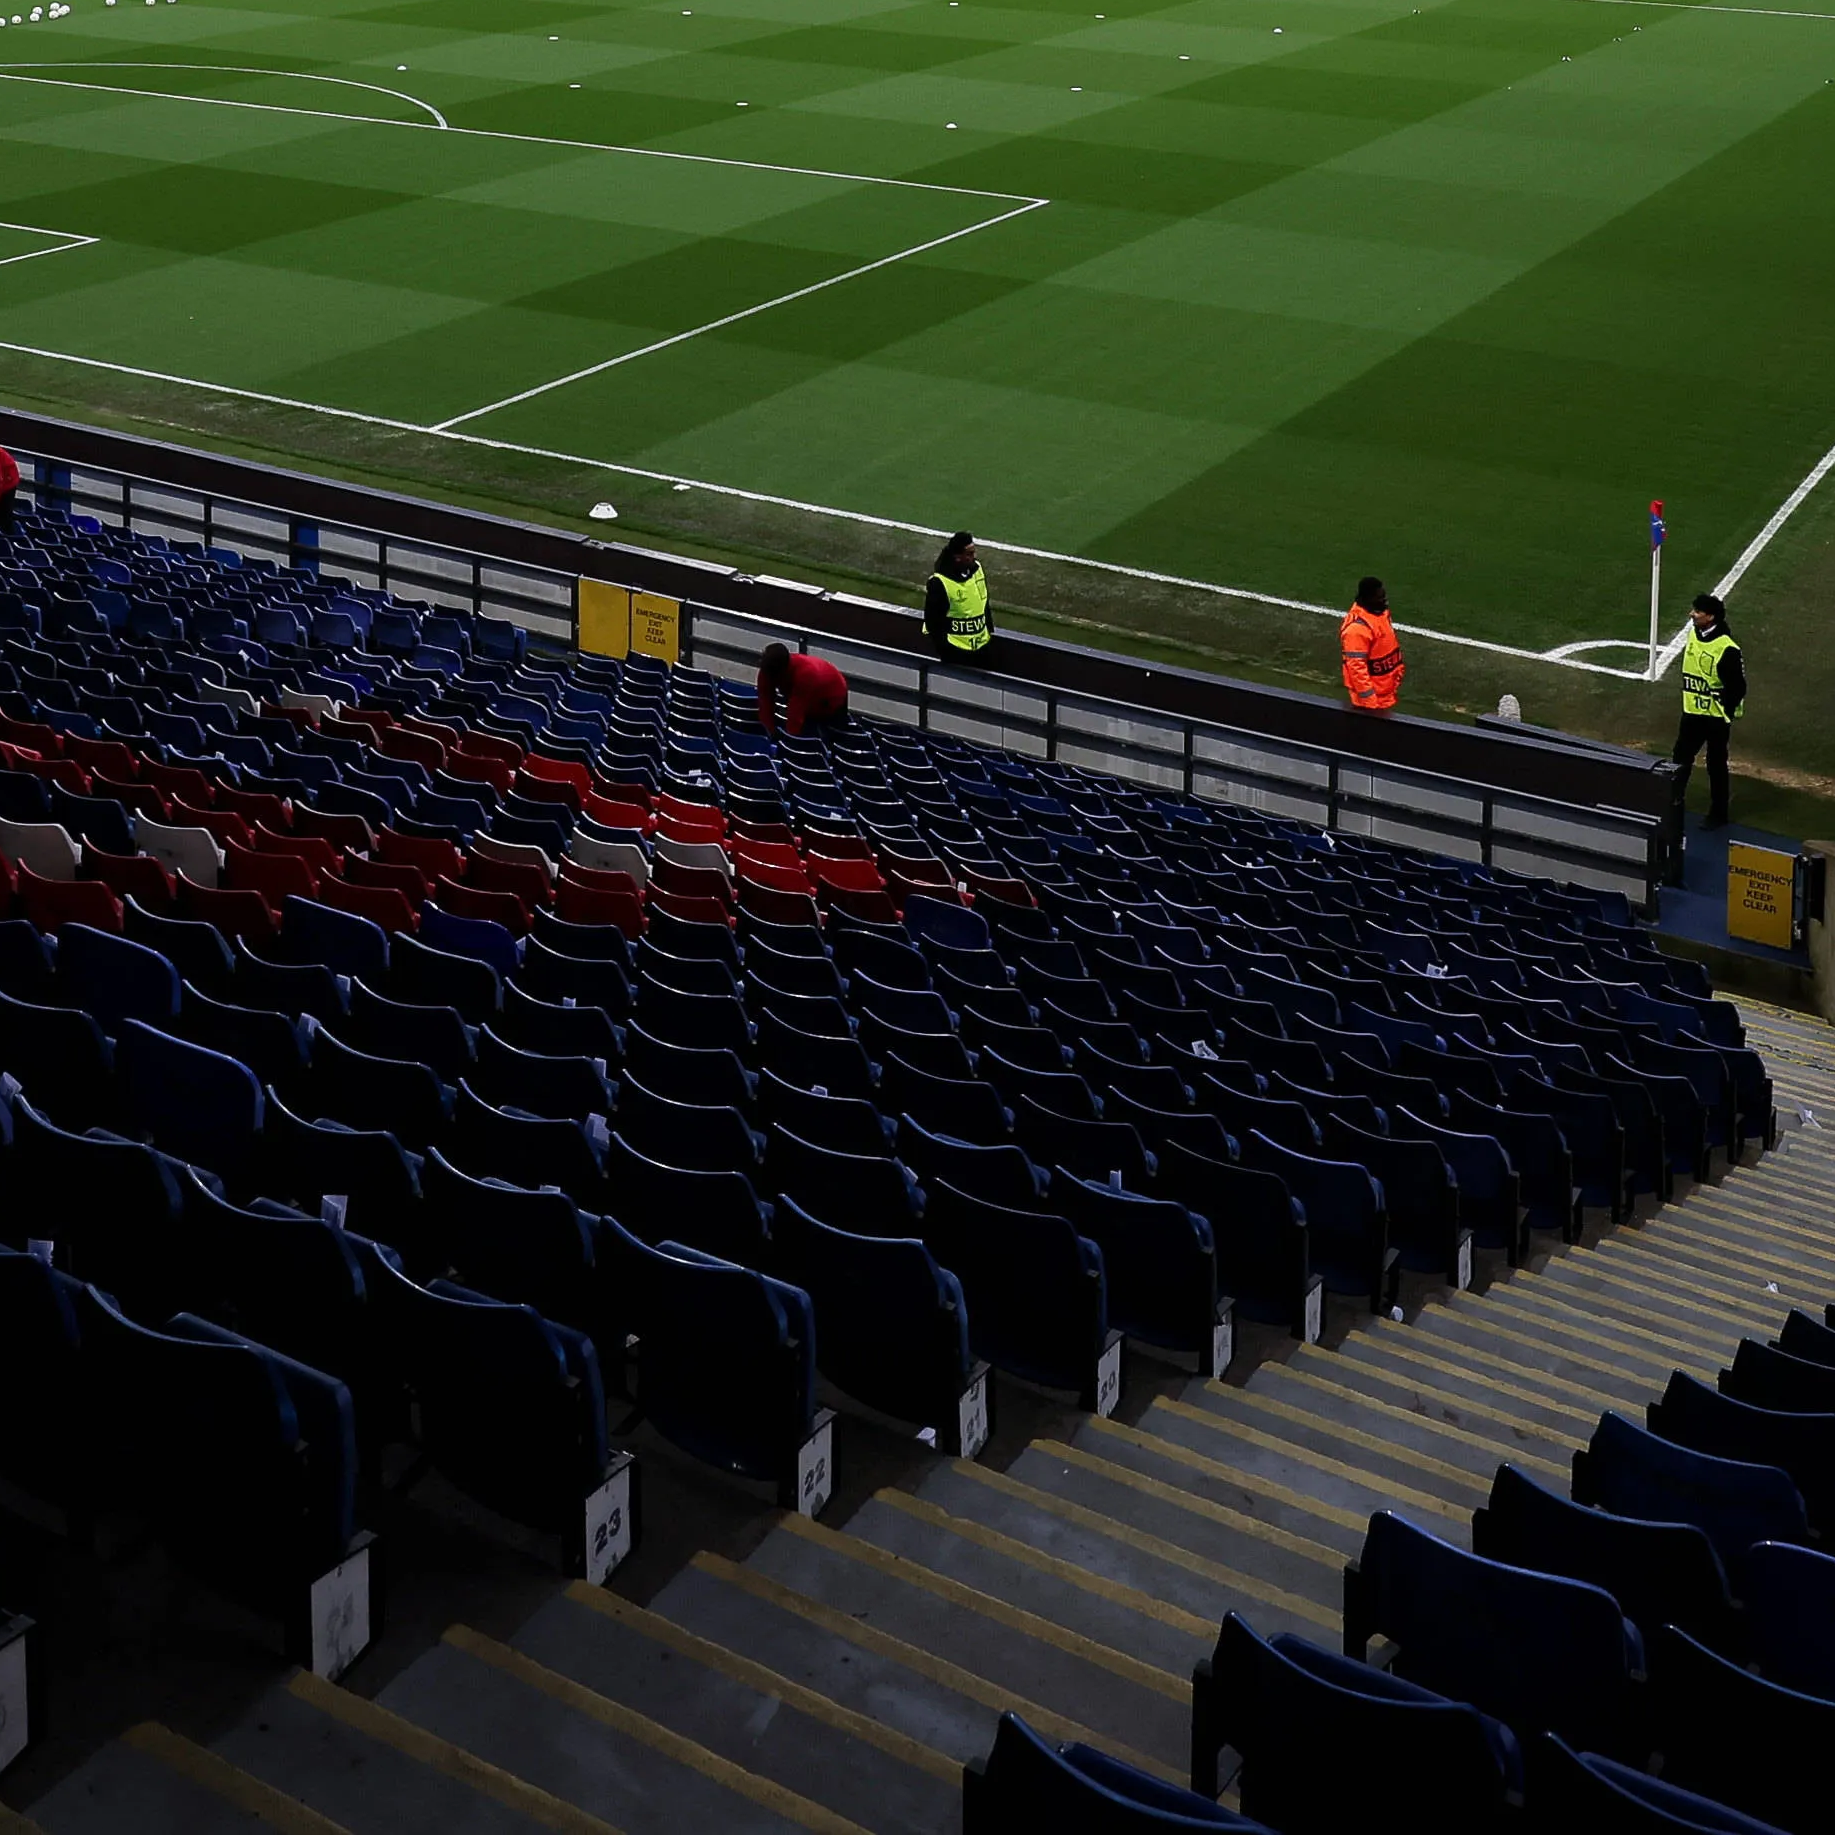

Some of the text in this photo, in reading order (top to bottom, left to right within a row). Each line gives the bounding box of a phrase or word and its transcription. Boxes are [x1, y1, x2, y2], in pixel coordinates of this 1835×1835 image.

[636, 607, 675, 623] EMERGENCY
[648, 619, 663, 628] EXIT
[647, 627, 664, 636] KEEP
[645, 635, 666, 645] CLEAR
[1729, 865, 1794, 887] EMERGENCY
[1749, 879, 1771, 892] EXIT
[1746, 889, 1774, 902] KEEP
[1742, 898, 1777, 914] CLEAR
[804, 1457, 826, 1498] 22
[593, 1506, 621, 1557] 23
